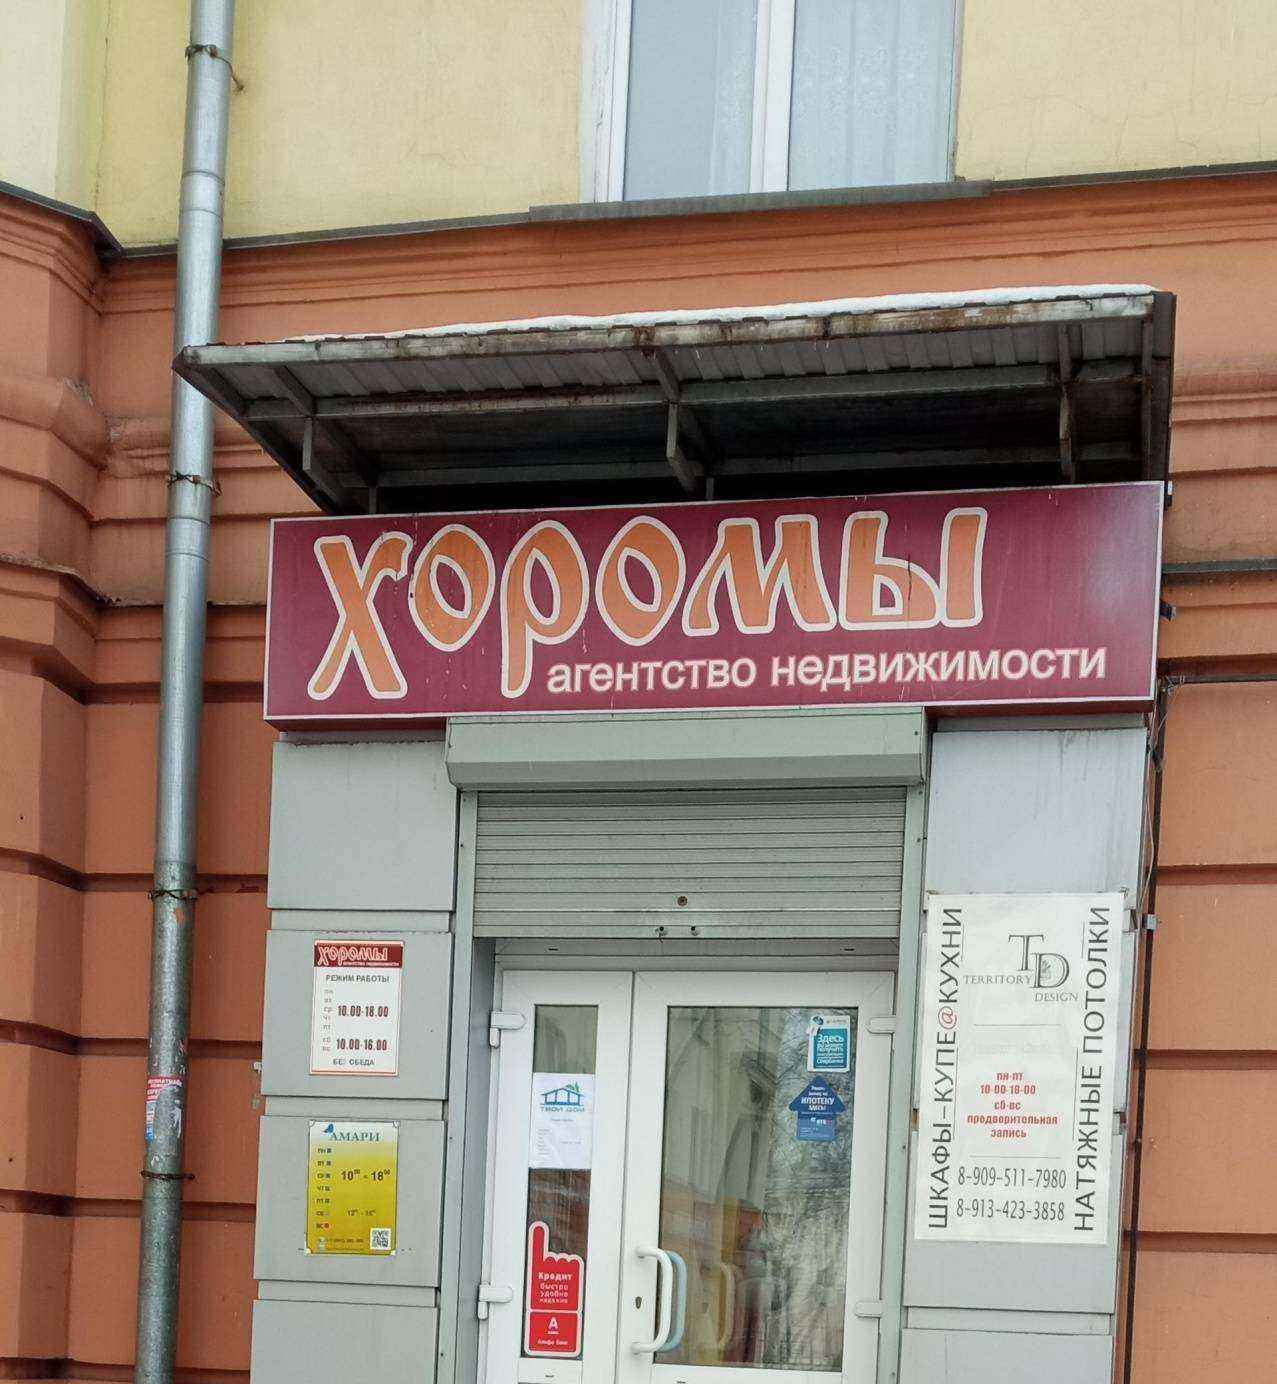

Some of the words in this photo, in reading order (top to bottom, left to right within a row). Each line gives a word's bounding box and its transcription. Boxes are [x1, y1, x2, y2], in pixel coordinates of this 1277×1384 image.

[547, 654, 757, 694] агентство
[772, 646, 1107, 690] недвижимости
[326, 974, 355, 982] РЕЖИМ
[356, 974, 390, 983] РАБОТЫ
[963, 974, 1032, 985] TERRITORY
[1082, 907, 1110, 1053] ПОТОЛКИ
[1034, 991, 1079, 1002] DESIGN
[801, 1097, 835, 1105] ИПОТЕКУ
[330, 1132, 380, 1142] АМАРИ
[990, 1128, 1027, 1140] запись
[1074, 1066, 1102, 1231] НАТЯЖНЫЕ
[957, 1165, 1067, 1190] 8-909-511-7980
[956, 1197, 1065, 1222] 8-913-423-3858
